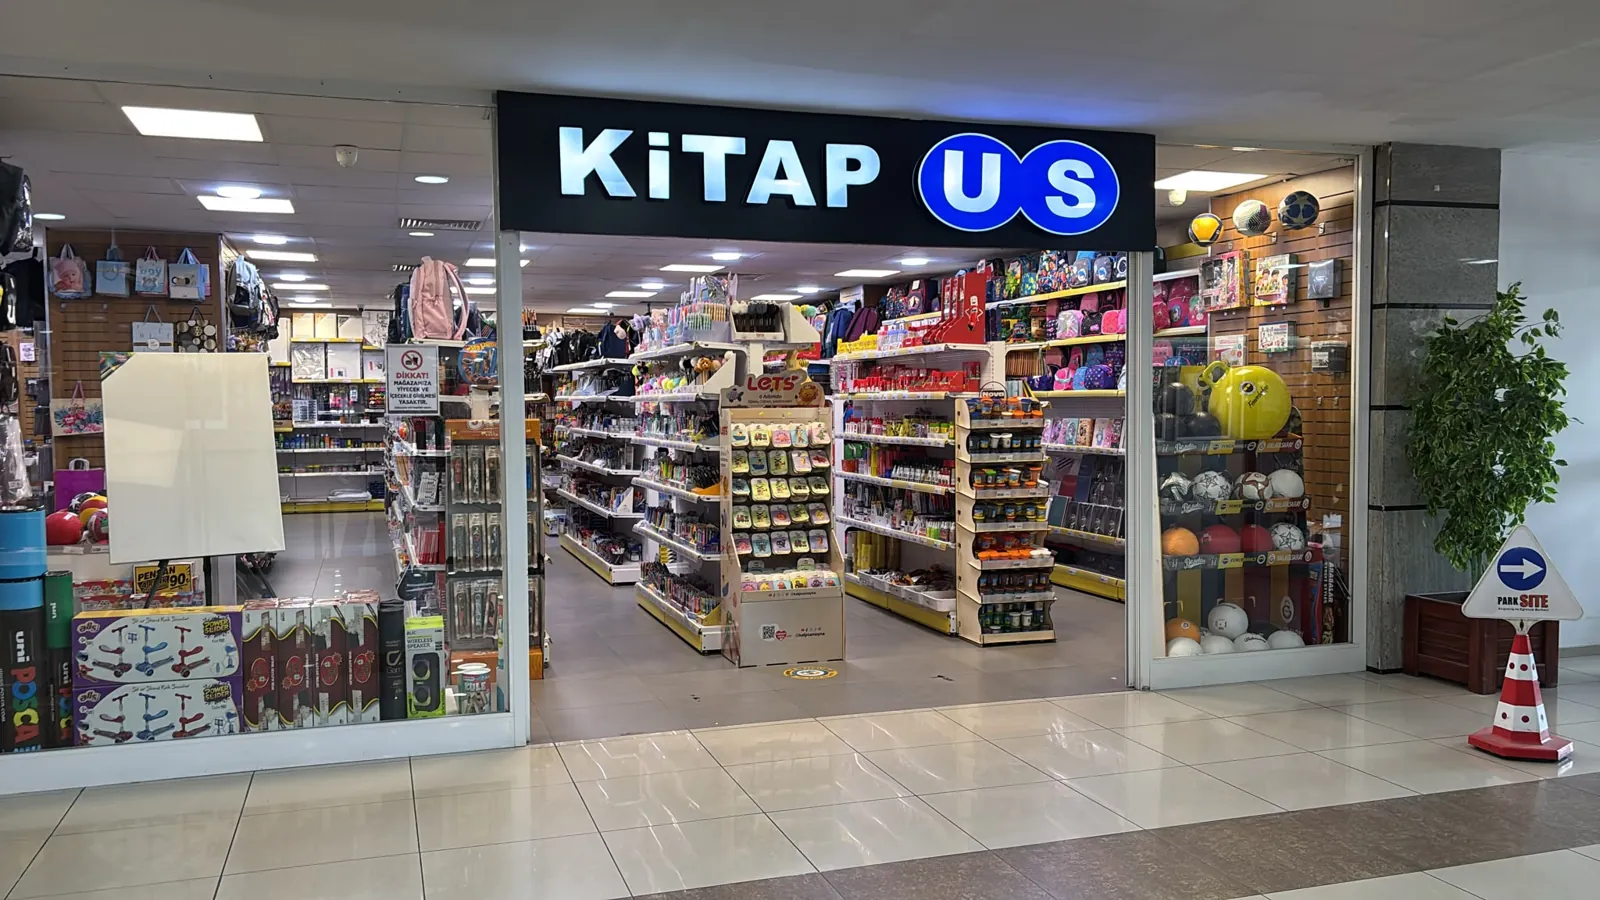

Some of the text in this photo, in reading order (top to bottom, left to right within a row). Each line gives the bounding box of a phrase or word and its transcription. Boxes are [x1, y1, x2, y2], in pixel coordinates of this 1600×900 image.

[396, 371, 429, 379] DİKKAT!
[15, 631, 30, 663] uni
[62, 662, 71, 684] uni
[10, 666, 39, 744] POSCA
